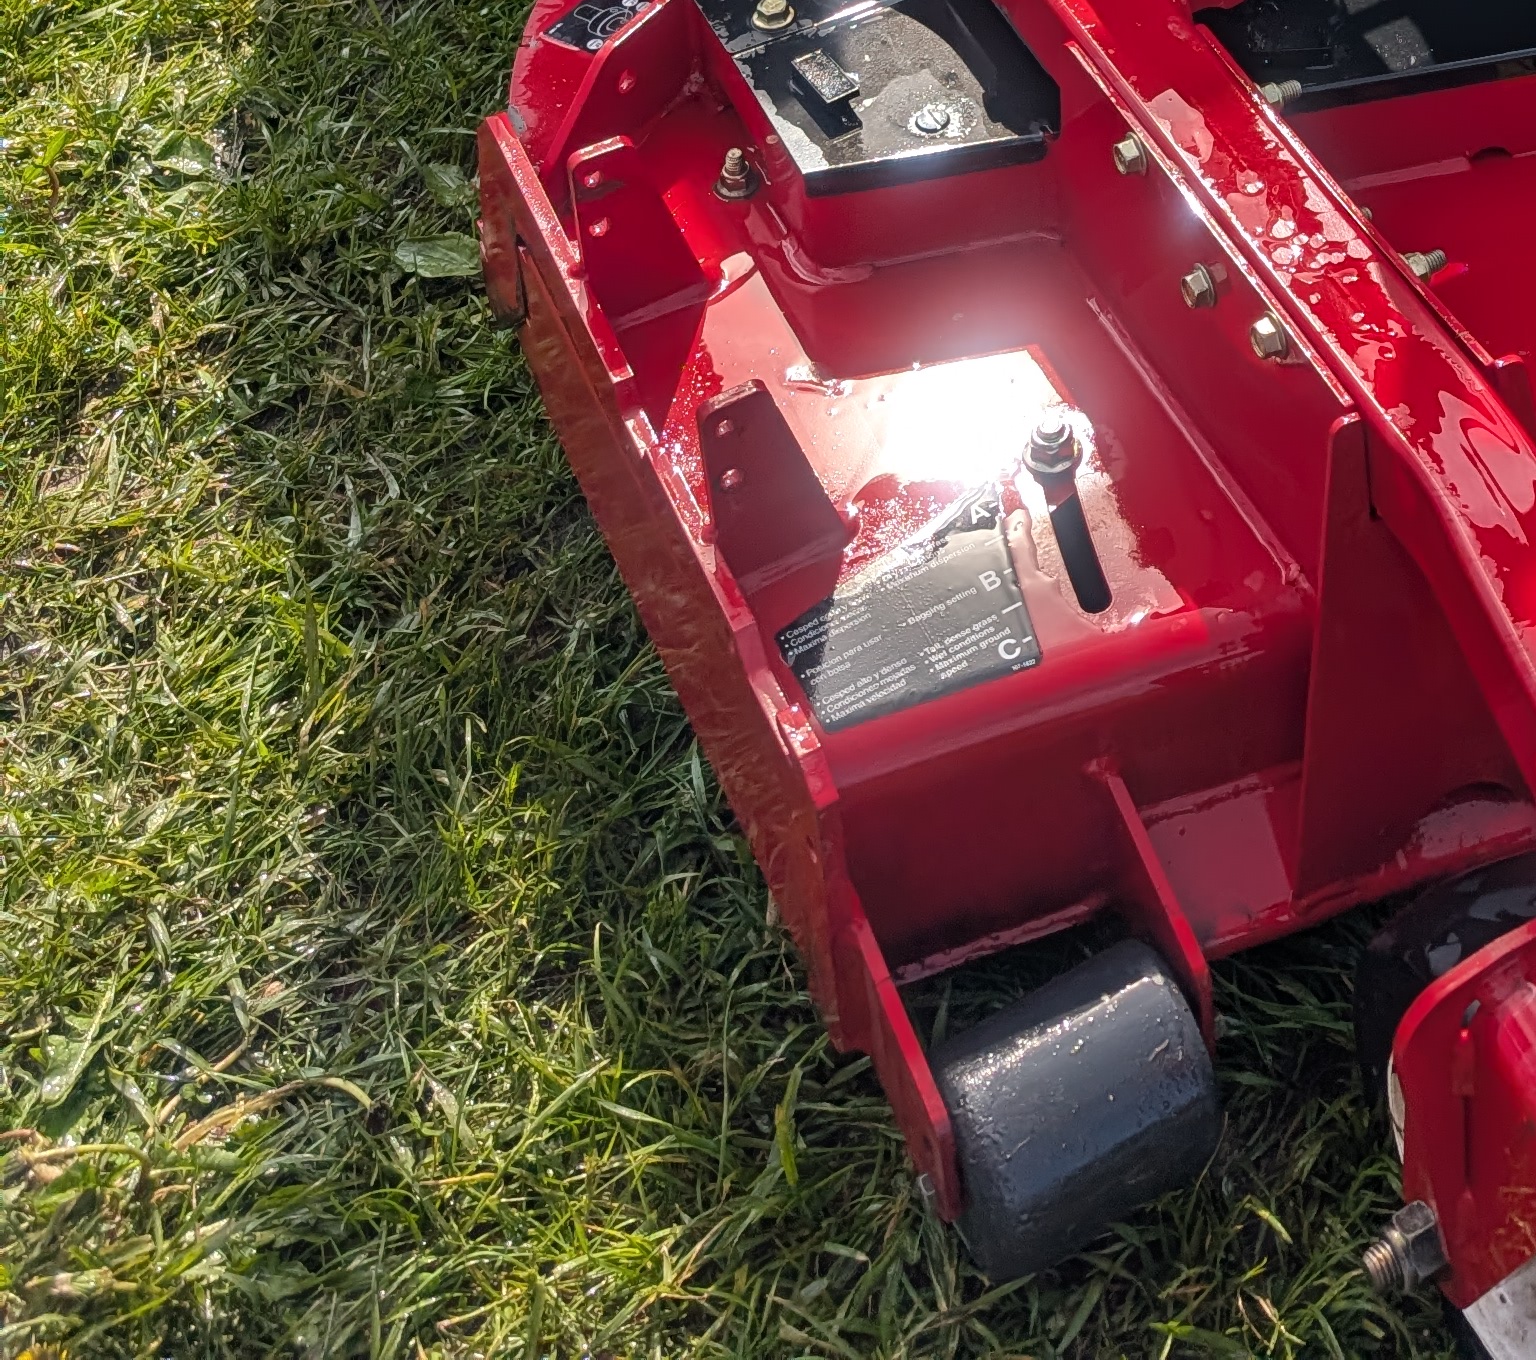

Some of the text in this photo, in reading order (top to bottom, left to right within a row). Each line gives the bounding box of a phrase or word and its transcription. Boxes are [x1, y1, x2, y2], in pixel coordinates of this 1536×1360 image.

[970, 503, 991, 524] A
[930, 543, 976, 568] dispersion
[978, 571, 1001, 591] B
[946, 587, 977, 606] setting
[944, 627, 971, 645] dense
[972, 614, 998, 632] grass
[948, 626, 995, 653] conditions
[842, 645, 862, 660] para
[862, 634, 883, 648] usar
[934, 627, 1011, 670] Maximum ground
[998, 639, 1021, 660] C
[810, 674, 827, 686] con
[856, 677, 873, 688] alto
